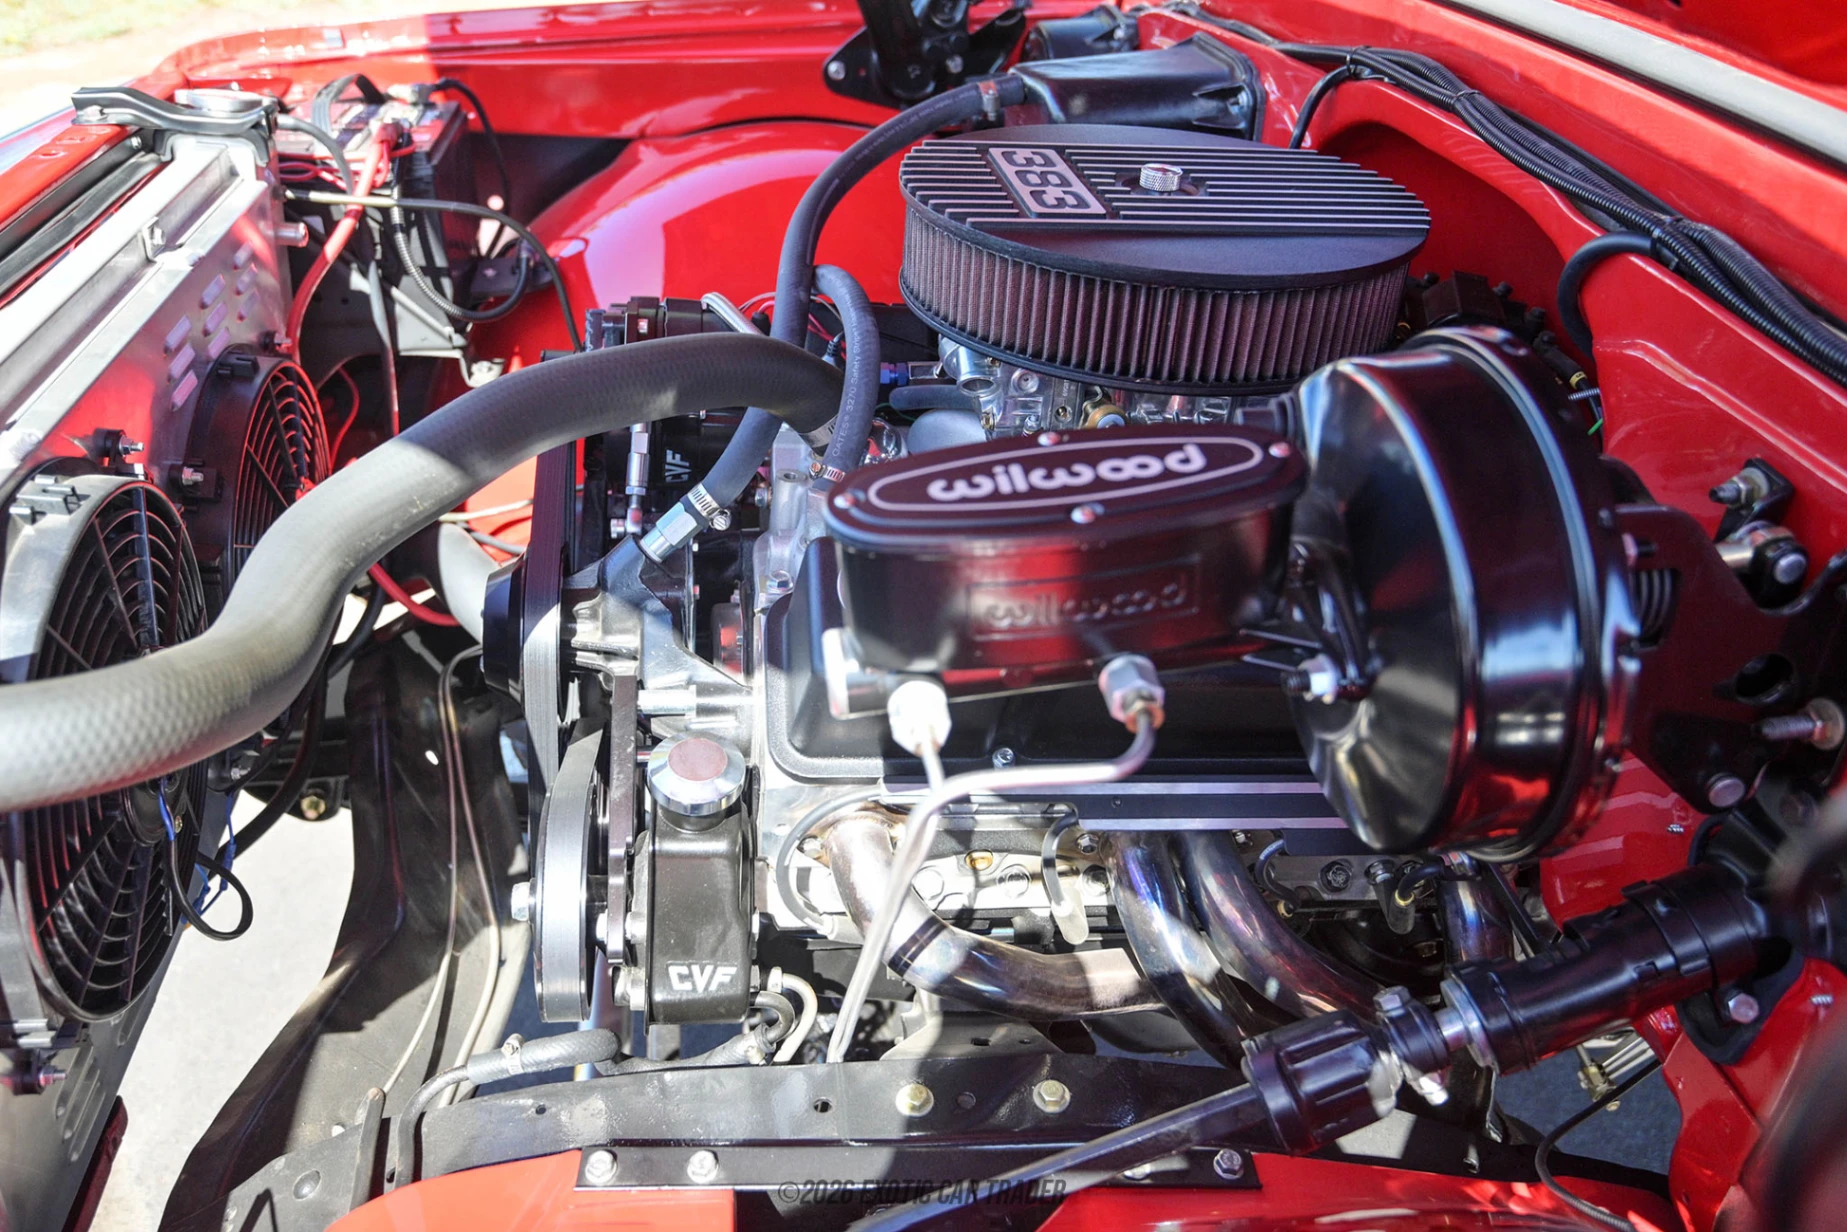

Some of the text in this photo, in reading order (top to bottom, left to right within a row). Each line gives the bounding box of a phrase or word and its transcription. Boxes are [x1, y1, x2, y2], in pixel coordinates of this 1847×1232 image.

[1001, 151, 1092, 209] 383
[851, 355, 861, 384] Safety
[845, 387, 858, 412] 3270
[665, 449, 691, 483] CVF
[927, 443, 1207, 501] wilwood
[668, 964, 737, 993] CVF
